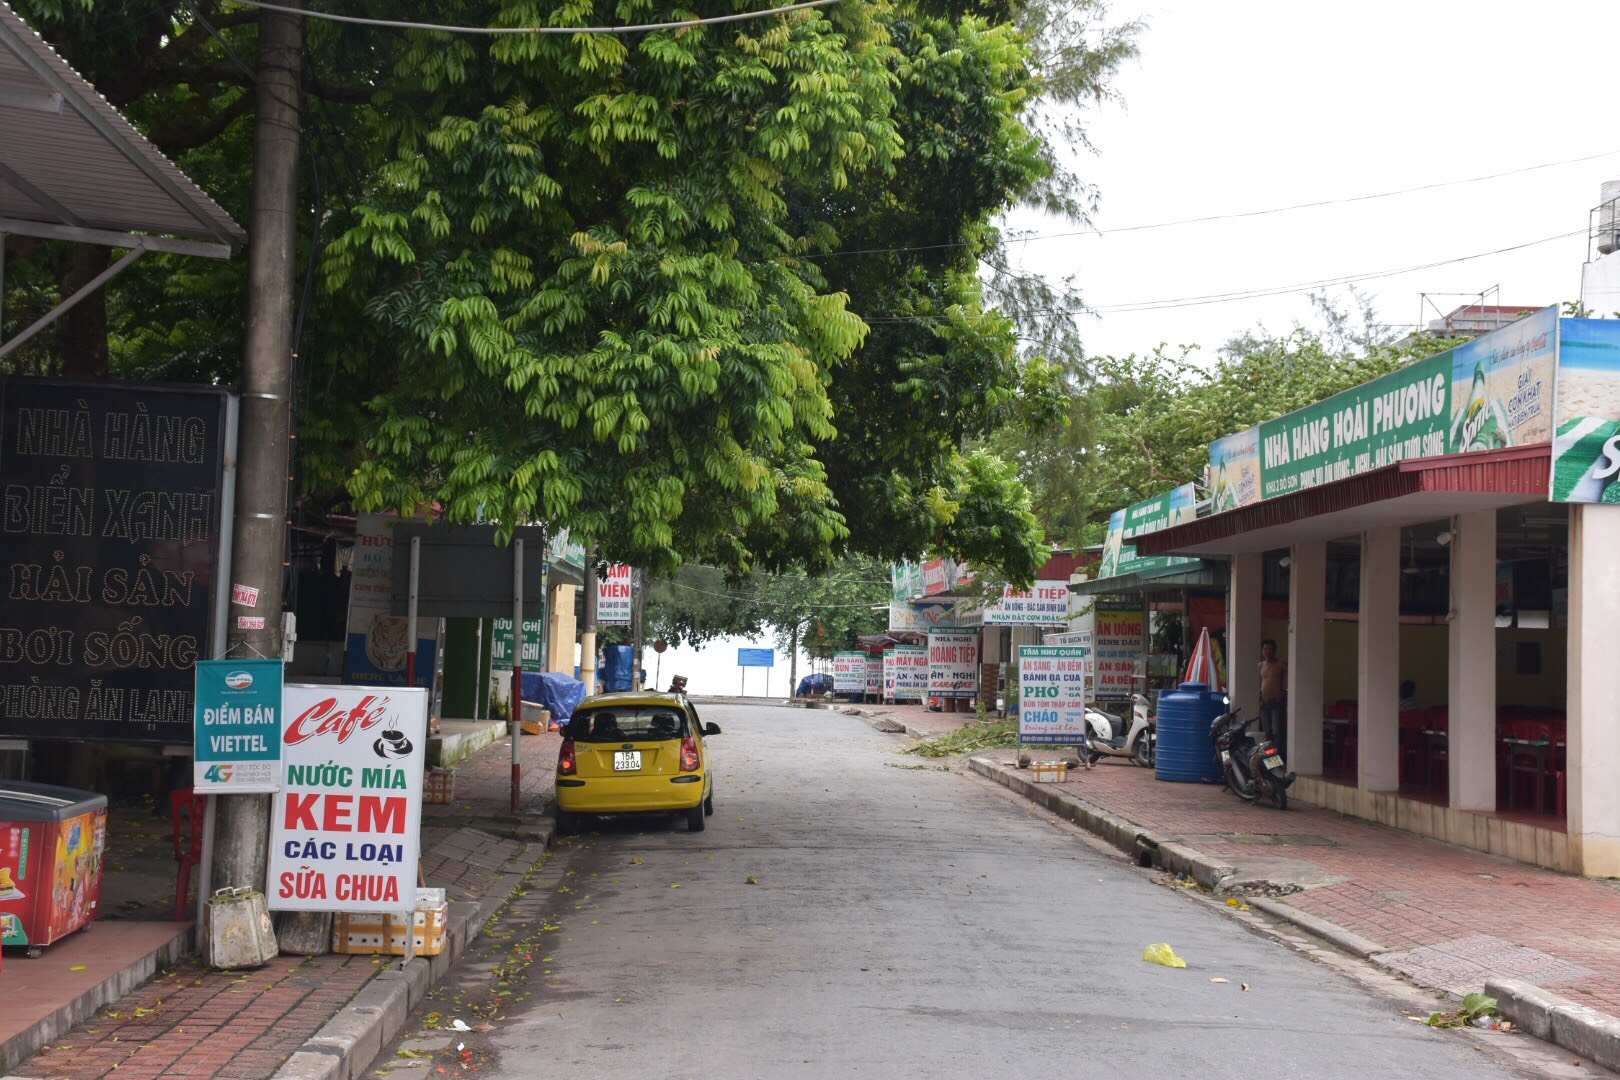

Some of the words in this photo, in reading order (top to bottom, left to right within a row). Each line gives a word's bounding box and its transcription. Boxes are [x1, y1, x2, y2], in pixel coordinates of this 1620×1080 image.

[1264, 424, 1290, 469] NHÀ
[1292, 416, 1330, 461] HÀNG
[1333, 396, 1368, 448] HOÀI
[1373, 373, 1445, 435] PHƯƠNG
[16, 399, 93, 458] NHÀ
[103, 402, 206, 463] HÀNG
[1325, 462, 1333, 483] ĂN
[1333, 452, 1350, 481] UỐNG
[1355, 444, 1370, 474] NGHỈ
[1375, 438, 1387, 468] HẢI
[1388, 435, 1402, 464] SẢN
[1422, 422, 1444, 457] SỐNG
[1266, 481, 1276, 494] KHU
[1276, 481, 1280, 492] 2
[3, 464, 95, 536] BIỂN
[8, 550, 93, 602] HẢI
[102, 553, 195, 606] SẢN
[600, 582, 630, 598] VIÊN
[1038, 586, 1066, 601] TIỆP
[1005, 601, 1011, 611] ĂN
[1012, 602, 1023, 611] UỐNG
[992, 612, 1010, 621] NHẬN
[1012, 613, 1025, 621] ĐẶT
[1027, 612, 1040, 621] CƠM
[1097, 620, 1111, 636] ĂN
[1114, 619, 1141, 636] UỐNG
[84, 616, 199, 669] SỐNG
[930, 643, 956, 663] HOÀNG
[959, 643, 976, 667] TIỆP
[1023, 648, 1039, 656] TÂM
[1059, 648, 1082, 656] QUÁN
[1023, 659, 1032, 670] ĂN
[1034, 659, 1051, 670] SÁNG
[1057, 659, 1066, 670] ĂN
[1068, 660, 1082, 671] ĐÊM
[1099, 662, 1112, 671] ĂN
[930, 670, 944, 679] ĂN
[952, 671, 975, 679] NGHỈ
[1024, 672, 1046, 681] BÁNH
[1101, 674, 1114, 684] ĂN
[1117, 674, 1138, 684] ĐÊM
[1024, 682, 1060, 698] PHỞ
[84, 679, 125, 721] ĂN
[204, 702, 240, 725] ĐIỂM
[244, 704, 274, 724] BÁN
[283, 695, 391, 746] Café
[1024, 709, 1058, 722] CHÁO
[210, 735, 268, 752] VIETTEL
[204, 764, 234, 783] 4G
[287, 760, 353, 788] NƯỚC
[361, 764, 407, 790] MÍA
[284, 793, 408, 834] KEM
[284, 838, 337, 860] CÁC
[346, 842, 403, 866] LOẠI
[278, 866, 327, 900] SỮA
[335, 873, 399, 902] CHUA
